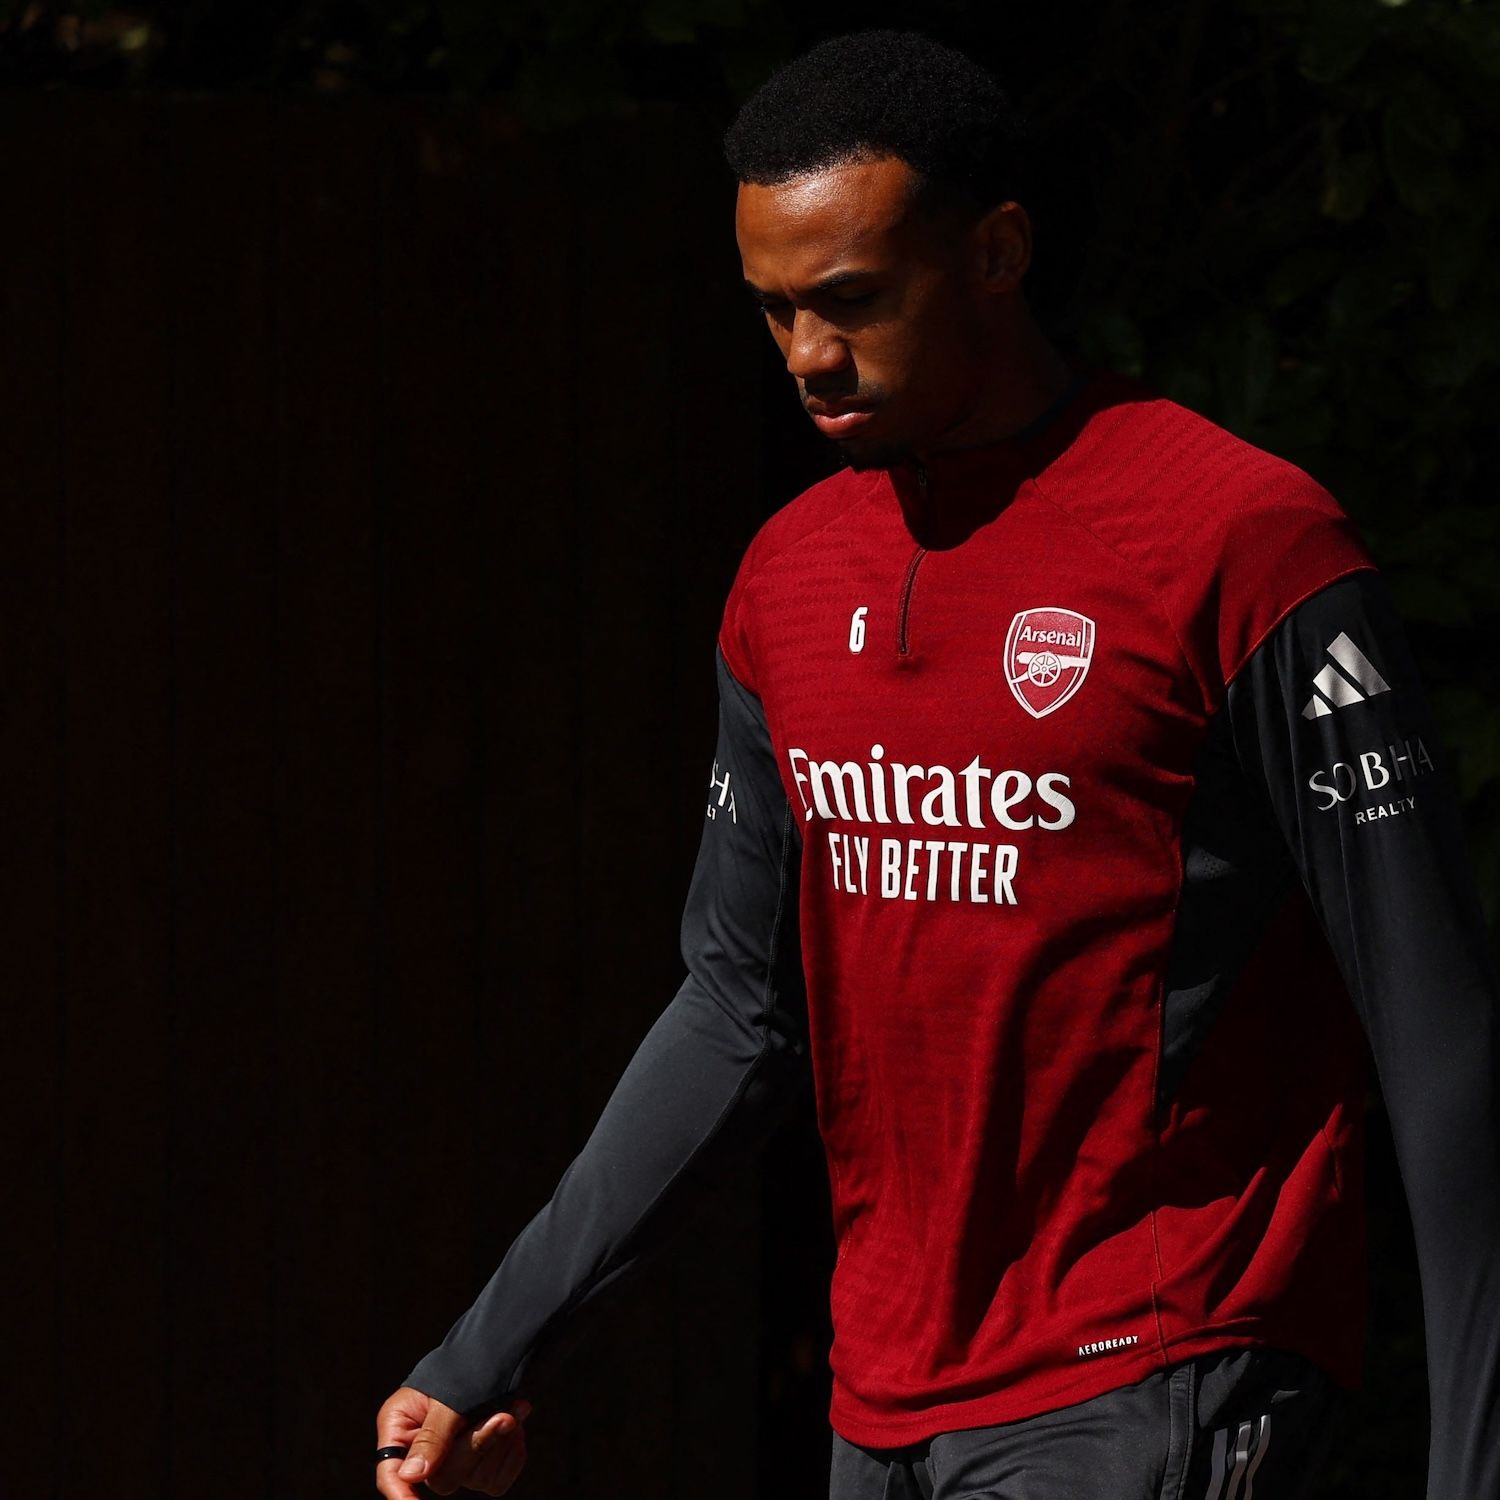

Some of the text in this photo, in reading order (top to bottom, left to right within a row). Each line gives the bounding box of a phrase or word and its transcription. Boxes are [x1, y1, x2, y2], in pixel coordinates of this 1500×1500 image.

[849, 606, 868, 653] 6
[1019, 625, 1081, 647] Arsenal
[788, 743, 1076, 831] Emirates
[1308, 737, 1435, 811] SOBHA
[1355, 796, 1415, 825] REALTY
[828, 832, 1018, 905] FLY BETTER
[1078, 1335, 1138, 1356] AEROREADY
